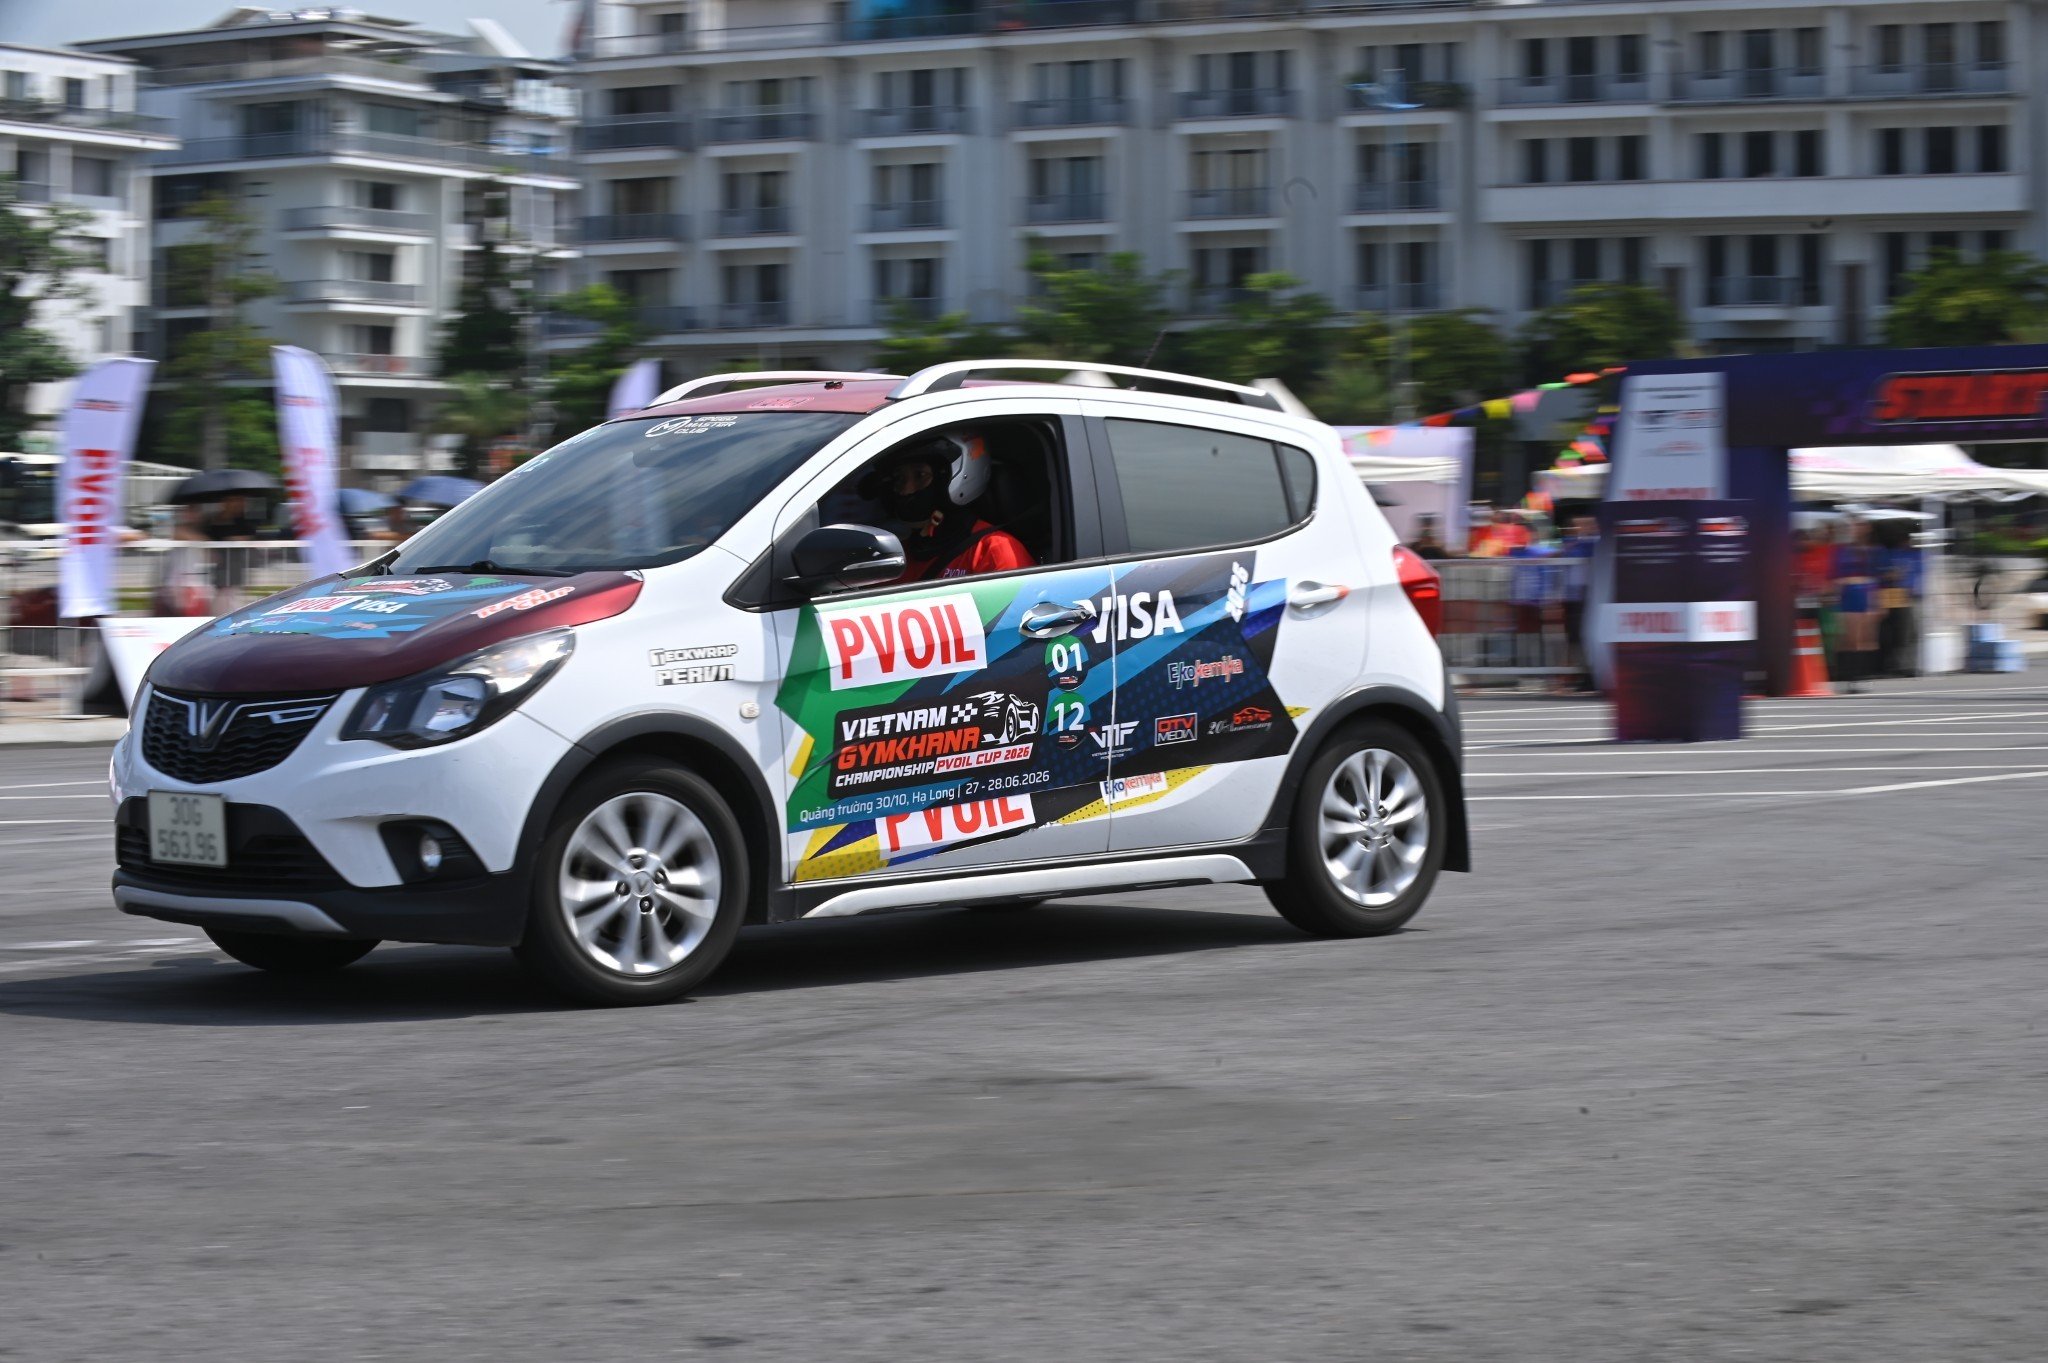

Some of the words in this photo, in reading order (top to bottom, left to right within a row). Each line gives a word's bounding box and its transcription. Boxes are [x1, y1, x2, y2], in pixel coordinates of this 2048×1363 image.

[350, 599, 408, 613] VISA
[1073, 589, 1185, 643] VISA
[829, 604, 976, 680] PVOIL
[1051, 642, 1083, 673] 01
[841, 706, 947, 741] VIETNAM
[1054, 702, 1084, 731] 12
[1158, 729, 1195, 742] MEDIA
[837, 726, 982, 770] GYMKHANA
[835, 762, 935, 788] CHAMPIONSHIP
[936, 754, 972, 771] PVOIL
[975, 751, 1002, 766] CUP
[1004, 747, 1030, 761] 2026
[800, 805, 835, 823] Quảng
[837, 797, 873, 815] trường
[876, 793, 909, 809] 30/10,
[912, 790, 927, 805] Hạ
[929, 786, 955, 802] Long
[965, 782, 978, 795] 27
[988, 771, 1050, 791] 28.06.2026
